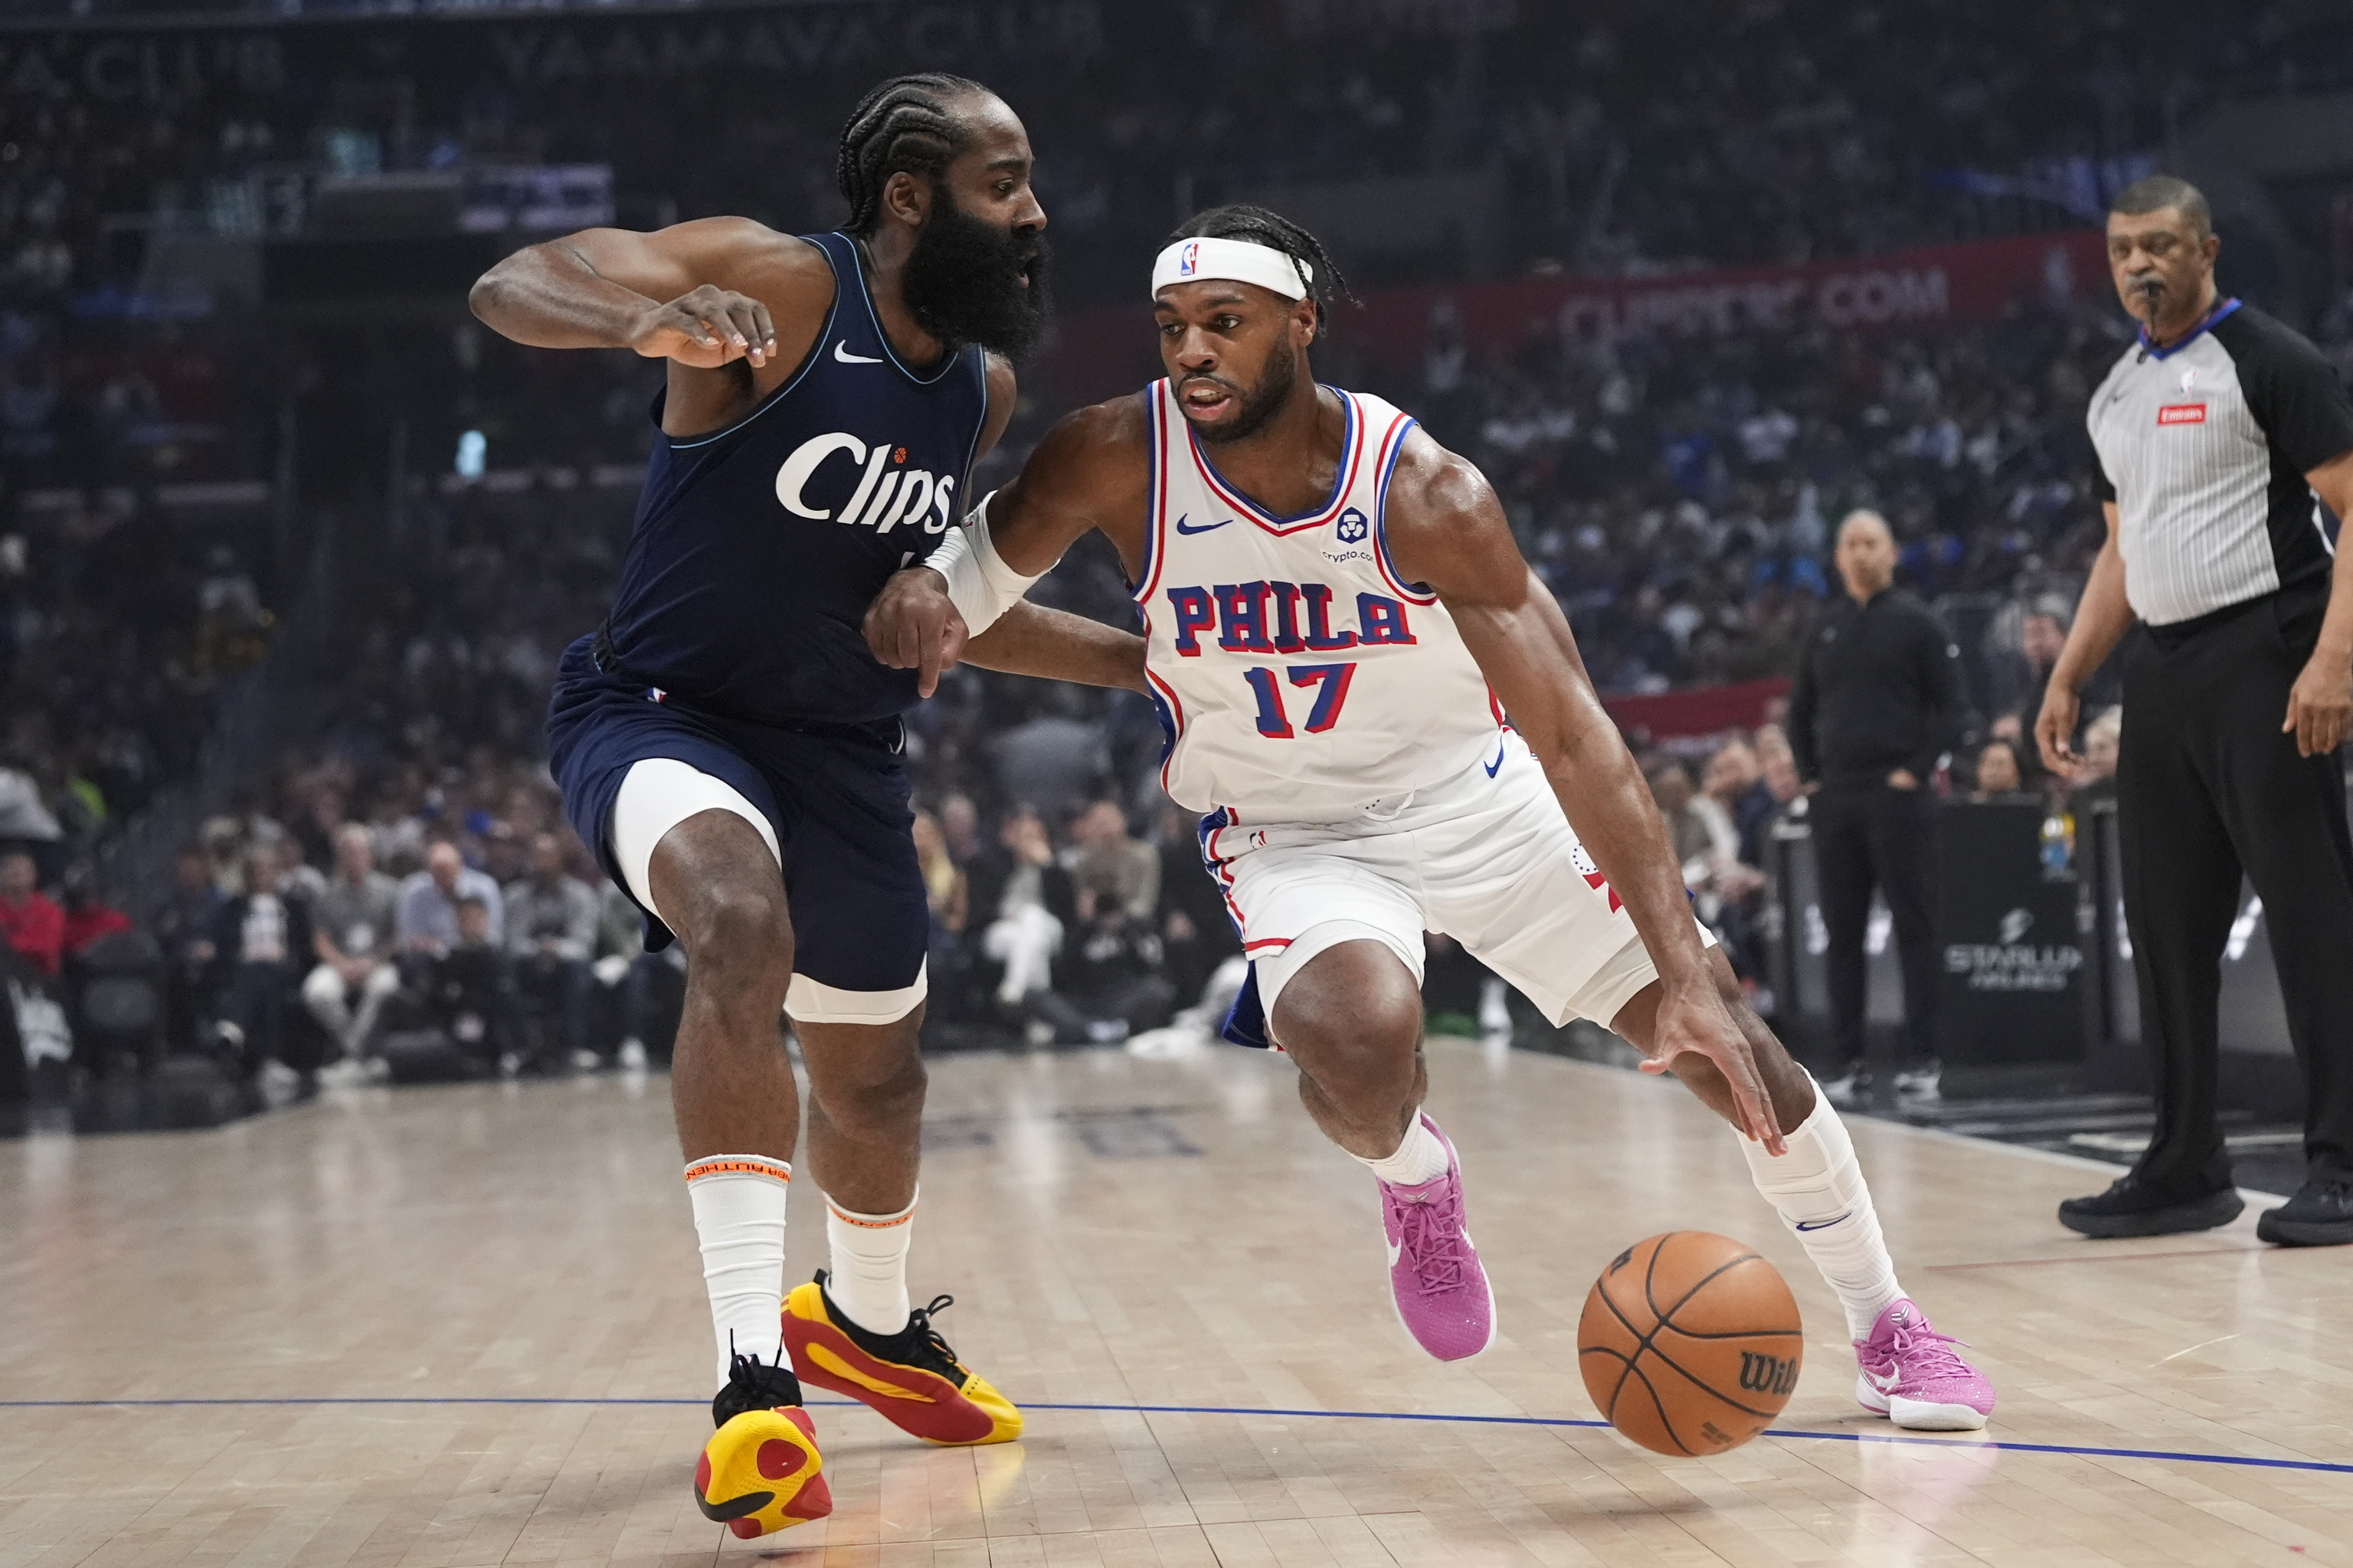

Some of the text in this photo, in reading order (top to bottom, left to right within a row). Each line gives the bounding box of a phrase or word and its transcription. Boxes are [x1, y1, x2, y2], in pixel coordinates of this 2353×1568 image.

[775, 432, 955, 534] Clips
[1167, 580, 1418, 657] PHILA
[1243, 663, 1357, 738] 17
